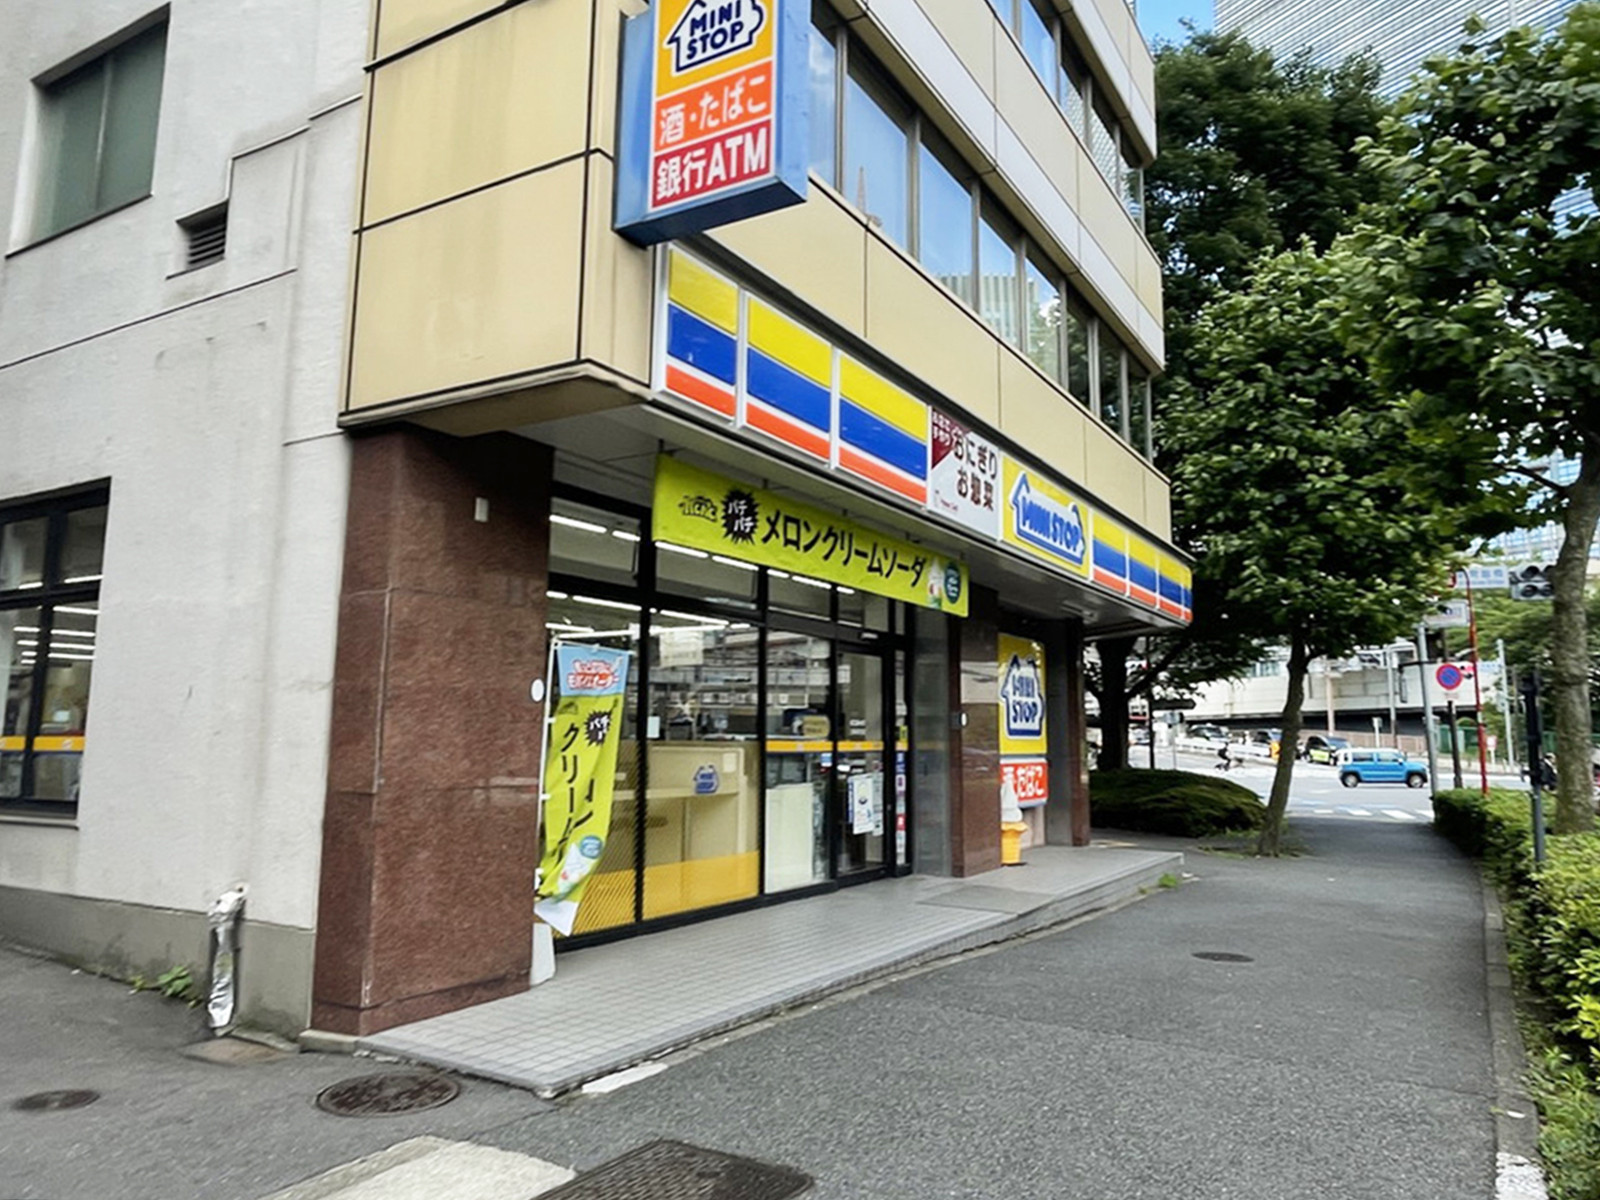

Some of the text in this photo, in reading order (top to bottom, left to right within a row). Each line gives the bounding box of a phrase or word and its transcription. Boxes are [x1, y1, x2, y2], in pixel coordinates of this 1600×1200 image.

[691, 0, 741, 37] MINI
[686, 20, 744, 60] STOP
[660, 75, 767, 145] 酒・たばこ
[656, 127, 768, 200] 銀行ATM
[762, 509, 927, 588] メロンクリームソーダ
[1052, 513, 1082, 551] STOP
[1012, 701, 1039, 723] STOP
